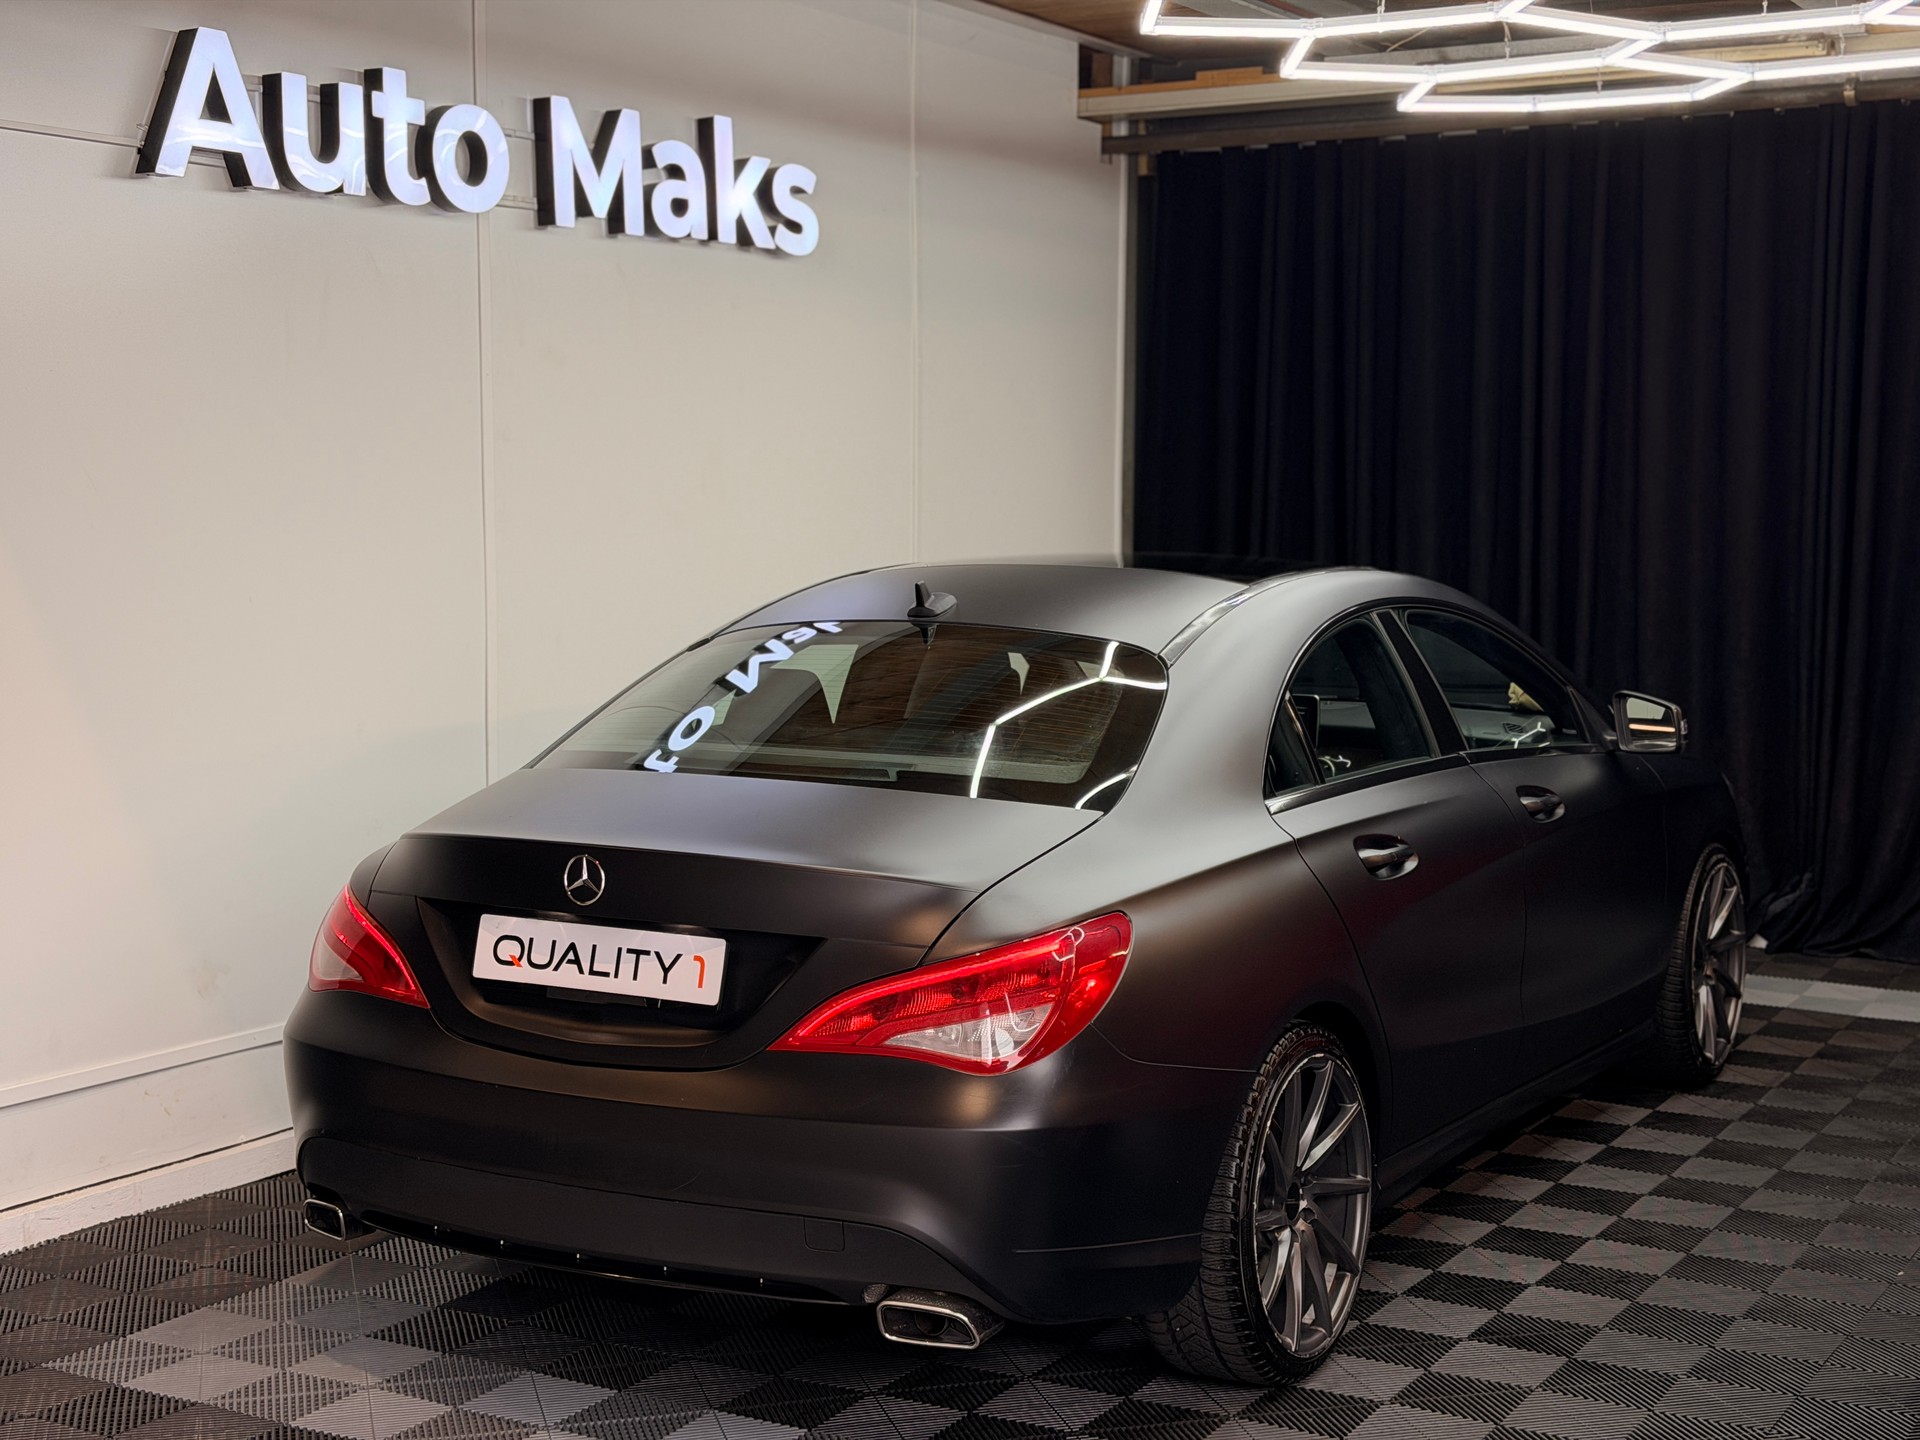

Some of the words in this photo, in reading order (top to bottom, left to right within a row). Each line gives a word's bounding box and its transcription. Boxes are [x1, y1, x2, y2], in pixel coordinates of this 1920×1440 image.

[138, 27, 510, 213] Auto
[534, 95, 819, 256] Maks
[493, 935, 683, 984] QUALITY
[693, 955, 706, 988] 1
